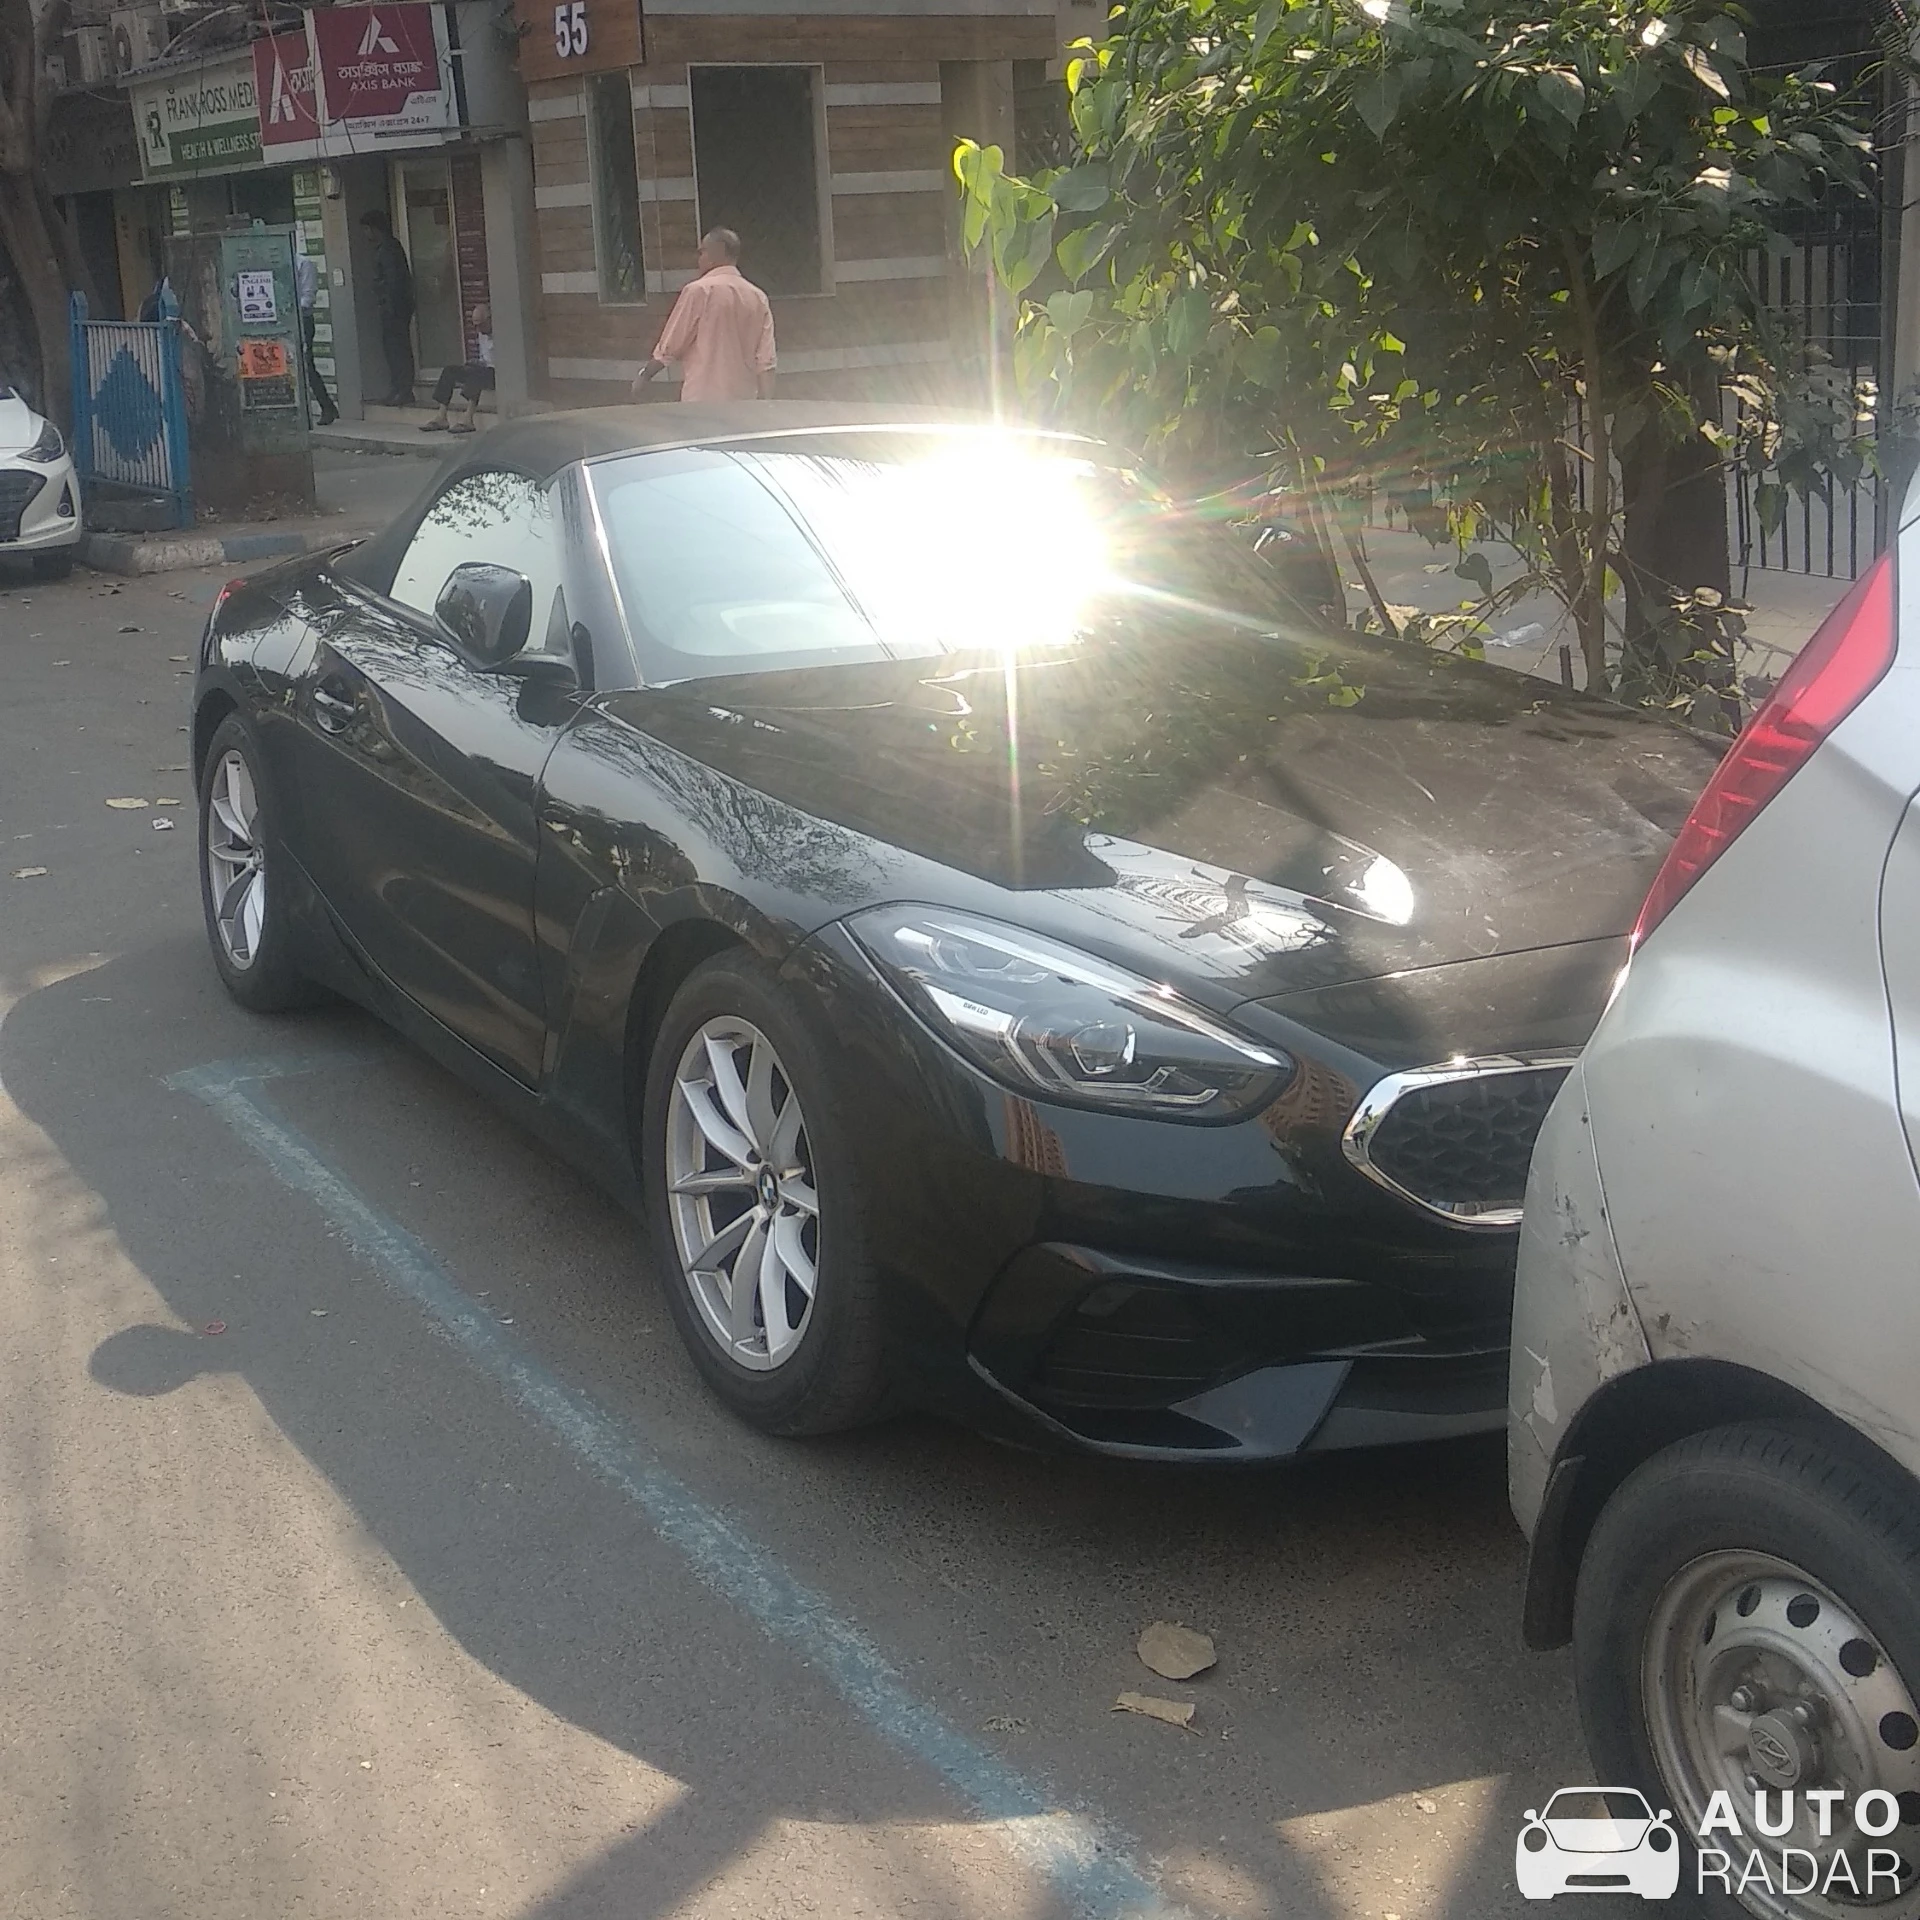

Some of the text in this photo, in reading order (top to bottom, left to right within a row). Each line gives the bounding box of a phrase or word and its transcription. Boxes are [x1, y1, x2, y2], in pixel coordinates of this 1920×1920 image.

[555, 1, 588, 58] 55
[350, 77, 416, 92] AXIS BANK
[166, 92, 199, 122] FRANK
[200, 86, 227, 116] ROSS
[213, 134, 249, 156] WELLNESS
[963, 1002, 989, 1016] BMW LED
